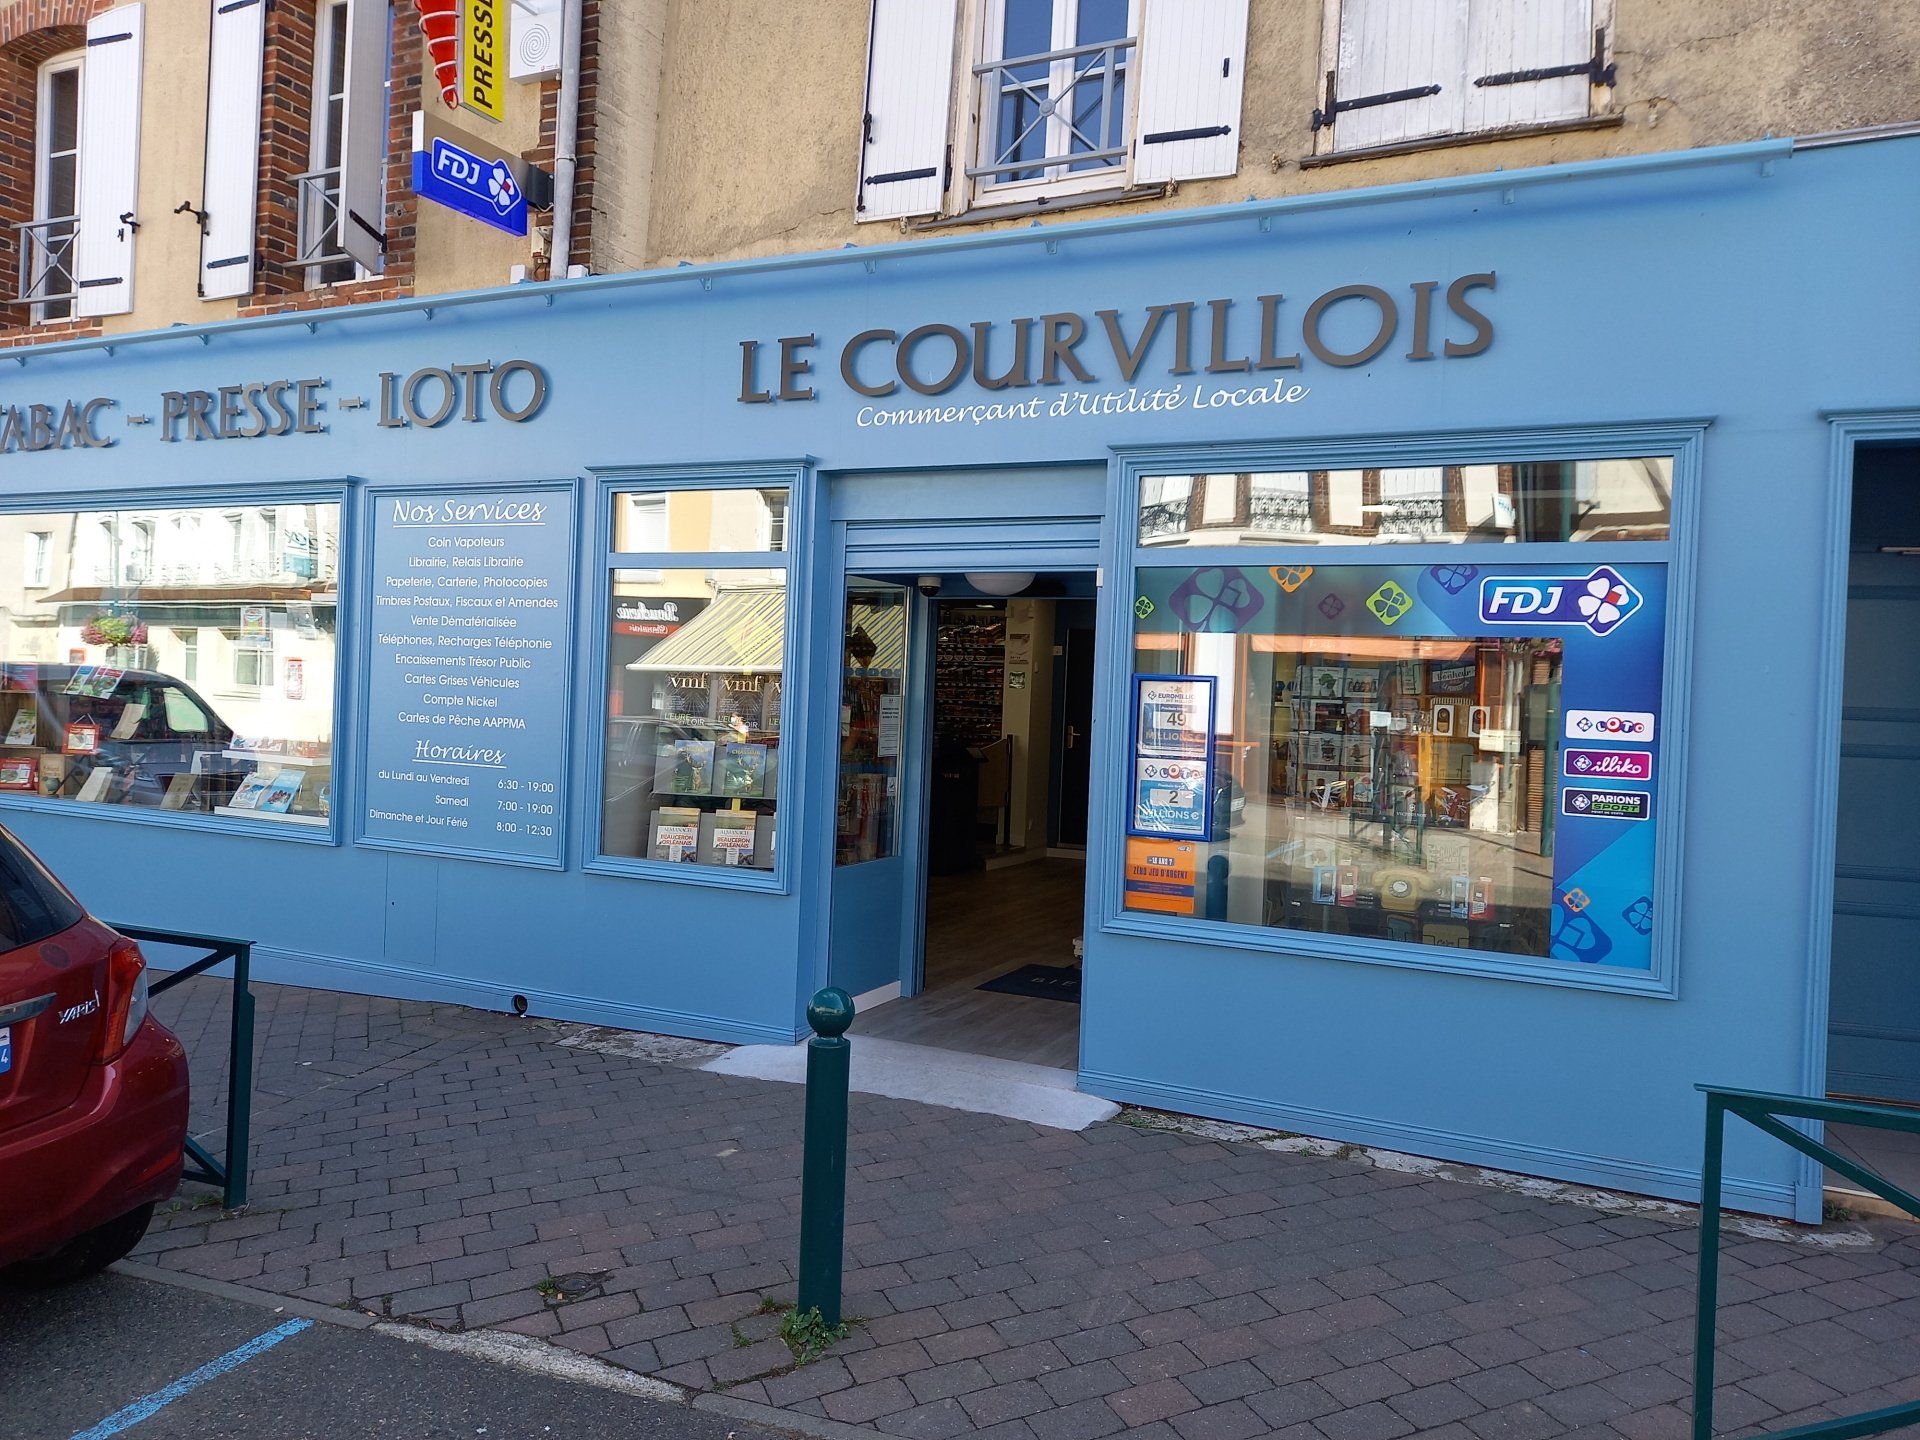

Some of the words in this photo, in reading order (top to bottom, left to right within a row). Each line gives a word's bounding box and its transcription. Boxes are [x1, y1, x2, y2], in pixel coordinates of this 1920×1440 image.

[436, 149, 481, 185] FDJ
[737, 333, 815, 402] LE
[840, 270, 1496, 397] COURVILLOIS
[0, 397, 115, 453] ABAC
[160, 376, 325, 442] PRESSE
[377, 359, 547, 427] LOTO
[856, 396, 1045, 426] Commerçant
[1050, 383, 1187, 417] d'Utilité
[1193, 378, 1311, 409] Locale
[392, 499, 439, 523] Nos
[441, 498, 547, 523] Services
[428, 537, 451, 548] Coin
[453, 537, 505, 549] Vapoteurs
[409, 557, 449, 568] Librairie,
[452, 557, 481, 568] Relais
[484, 557, 524, 568] Librairie
[386, 576, 434, 589] Papeterie,
[437, 577, 480, 588] Carterie,
[484, 577, 548, 589] Photocopies
[376, 595, 411, 606] Timbres
[414, 596, 452, 608] Postaux,
[455, 597, 492, 607] Fiscaux
[495, 598, 506, 607] et
[508, 597, 558, 608] Amendes
[1488, 586, 1563, 614] FDJ
[411, 615, 438, 626] Vente
[441, 615, 517, 628] Dématérialisée
[378, 633, 435, 646] Téléphones,
[438, 635, 491, 649] Recharges
[494, 637, 552, 650] Téléphonie
[395, 654, 466, 667] Encaissements
[468, 655, 497, 668] Trésor
[499, 657, 531, 669] Public
[405, 673, 436, 685] Cartes
[439, 674, 468, 686] Grises
[470, 676, 520, 689] Véhicules
[671, 672, 708, 689] vmf
[724, 675, 762, 692] vmf
[423, 693, 464, 707] Compte
[466, 696, 498, 707] Nickel
[398, 712, 430, 723] Cartes
[432, 713, 446, 724] de
[448, 714, 481, 726] Pêche
[483, 717, 526, 729] AAPPMA
[1167, 711, 1186, 726] 49
[1596, 717, 1645, 733] LOTO
[415, 739, 507, 764] Horaires
[1160, 764, 1200, 779] LOTO
[1591, 756, 1642, 774] illiko
[378, 770, 390, 779] du
[392, 770, 414, 781] Lundi
[416, 773, 428, 782] au
[430, 773, 470, 786] Vendredi
[498, 779, 518, 790] 6:30
[527, 781, 554, 793] 19:00
[435, 795, 469, 807] Samedi
[498, 801, 518, 812] 7:00
[526, 803, 553, 815] 19:00
[1169, 790, 1178, 804] 2
[1592, 794, 1640, 804] PARIONS
[1593, 803, 1639, 812] SPORT
[370, 809, 413, 822] Dimanche
[415, 813, 425, 823] et
[426, 815, 444, 826] Jour
[447, 816, 468, 828] Férié
[496, 822, 517, 833] 8:00
[526, 825, 552, 836] 12:30
